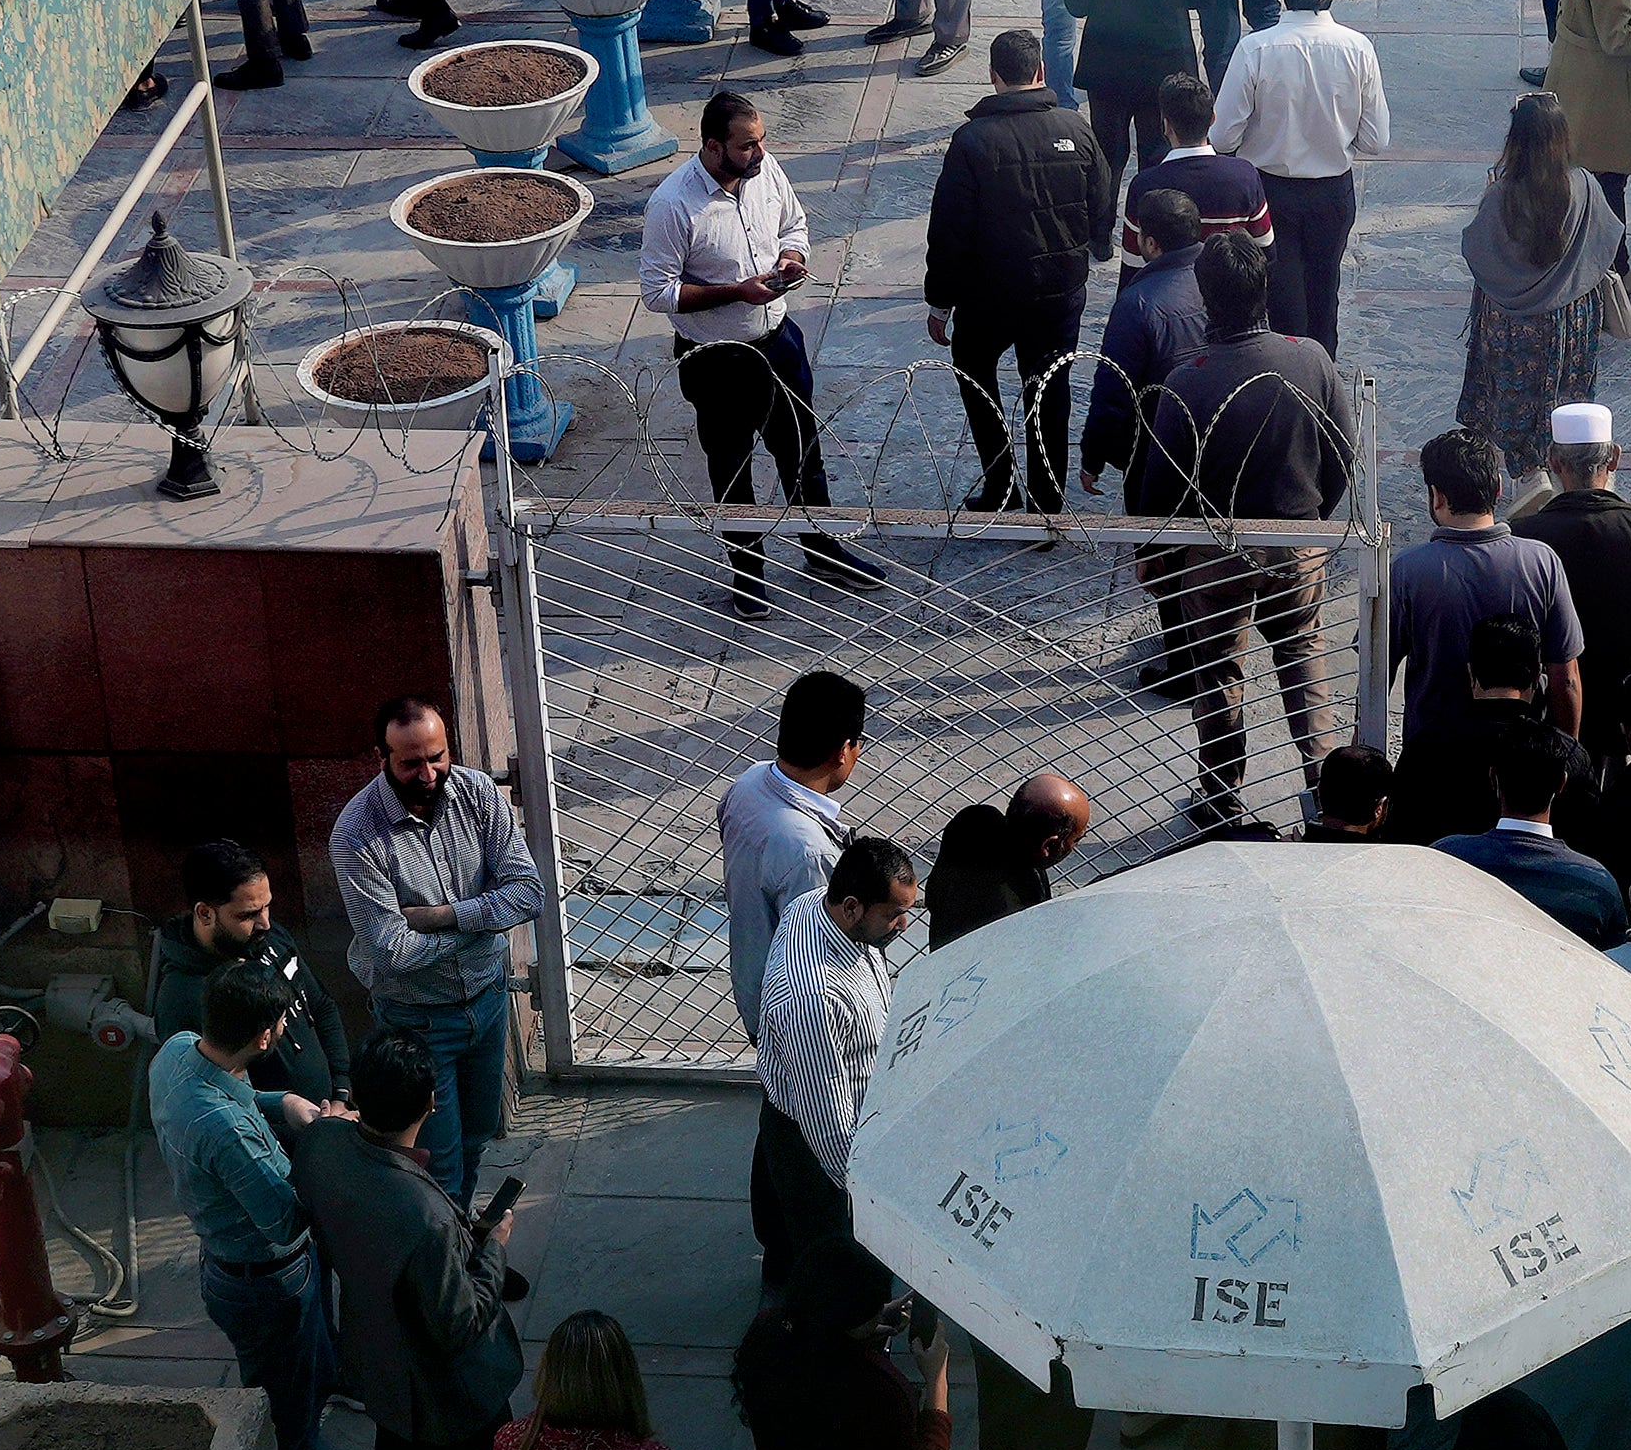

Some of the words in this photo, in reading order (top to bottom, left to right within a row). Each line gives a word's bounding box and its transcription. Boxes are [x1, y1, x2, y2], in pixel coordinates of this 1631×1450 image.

[887, 1000, 931, 1071] ISE
[936, 1170, 1017, 1254] ISE
[1489, 1212, 1582, 1289] ISE
[1190, 1276, 1290, 1329] ISE
